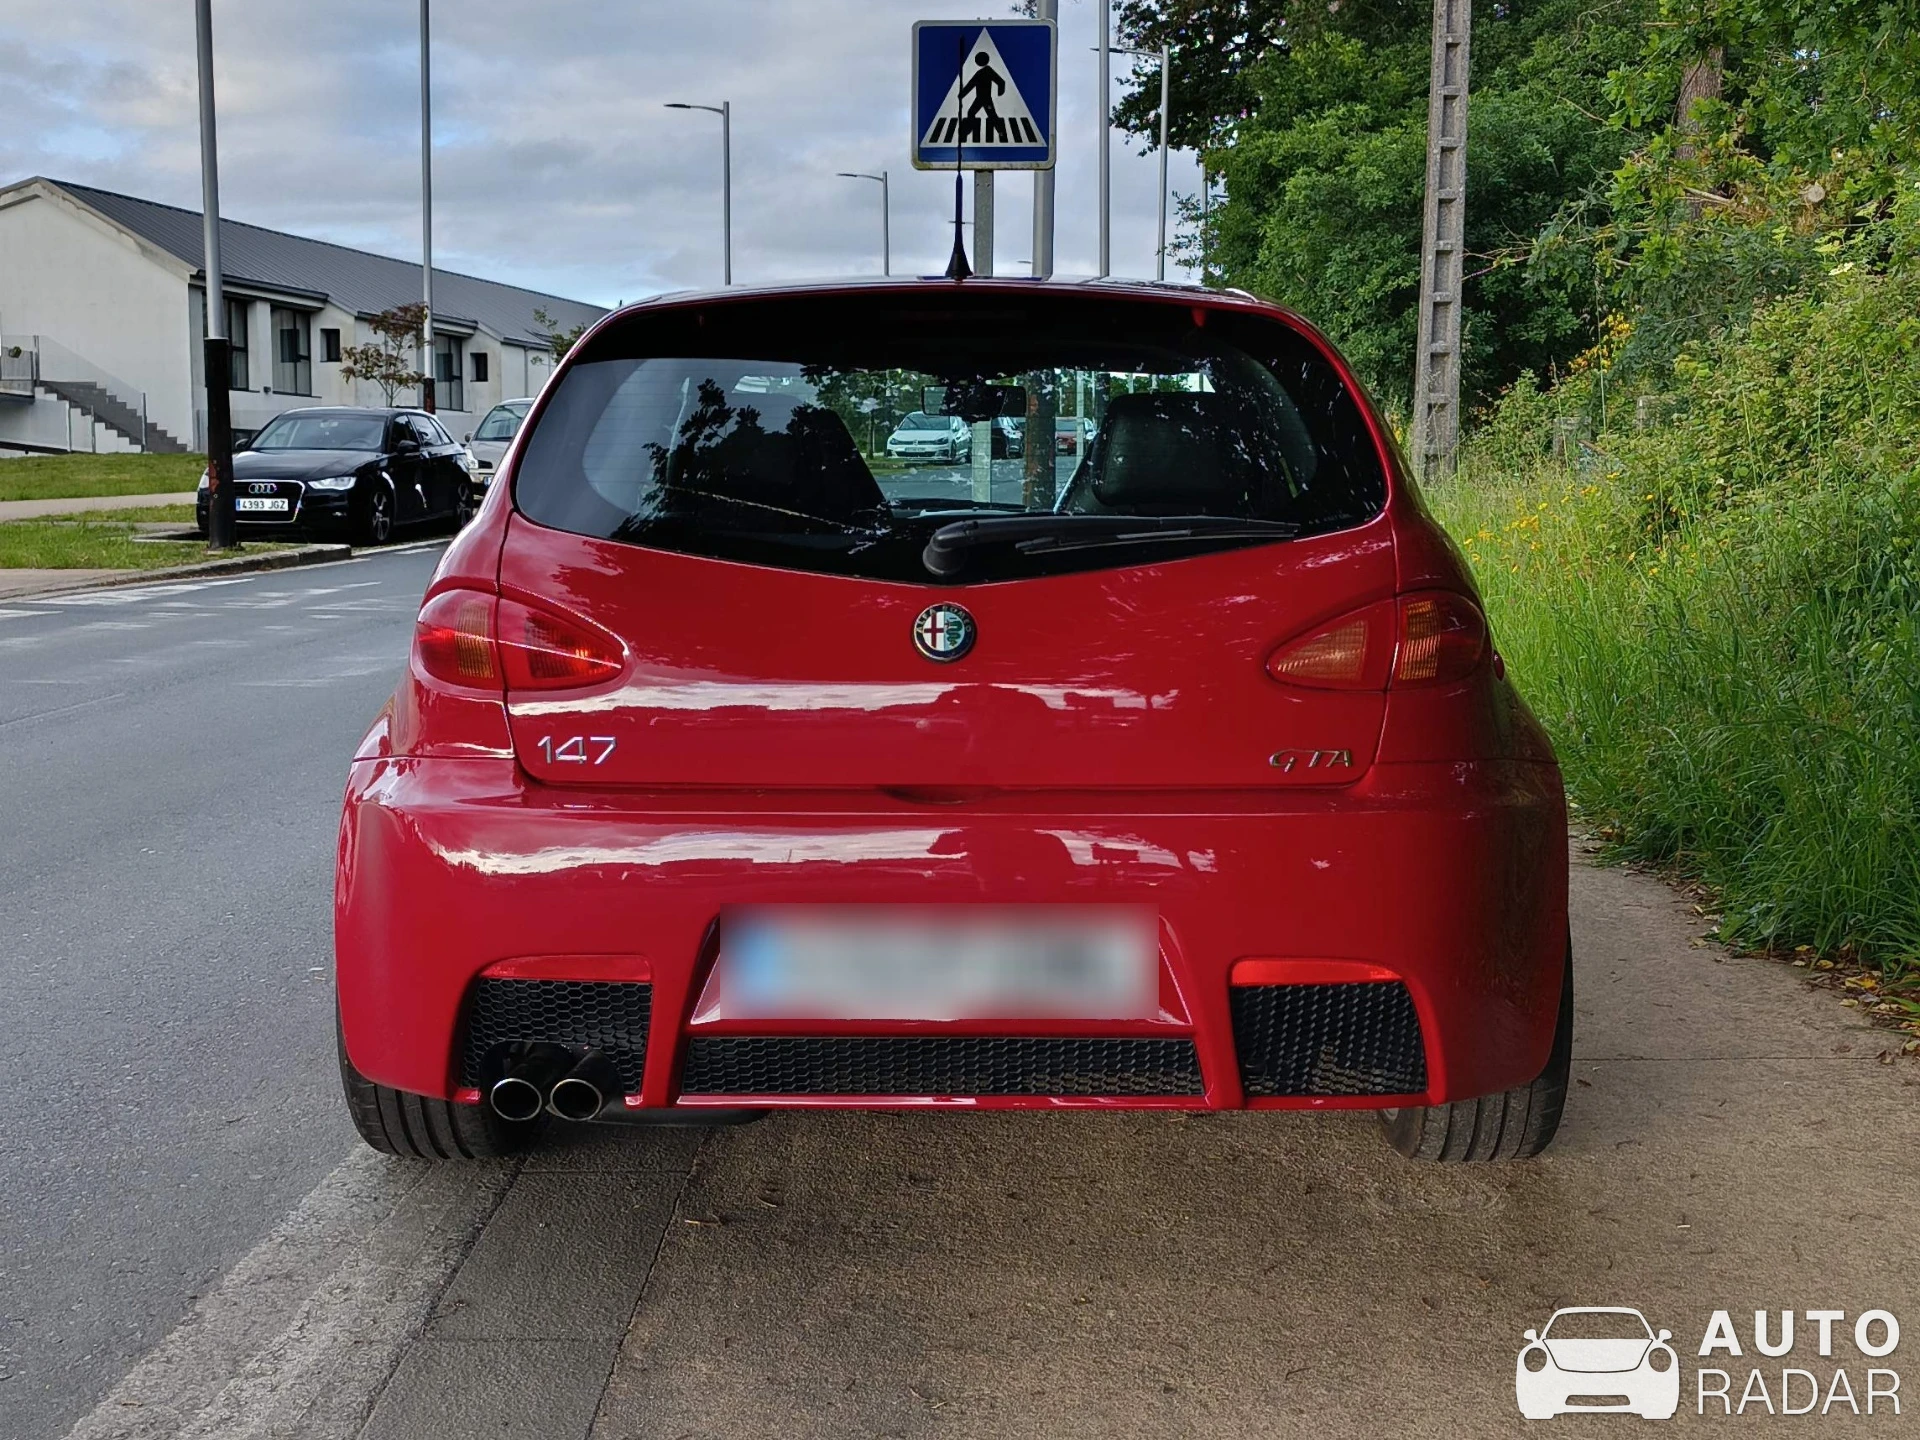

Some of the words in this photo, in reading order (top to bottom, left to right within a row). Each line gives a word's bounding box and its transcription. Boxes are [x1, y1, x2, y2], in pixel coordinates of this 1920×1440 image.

[242, 500, 265, 509] 4393
[268, 500, 286, 510] JGZ
[916, 608, 938, 634] ALFA
[537, 735, 616, 764] 147
[1268, 748, 1352, 772] GTA
